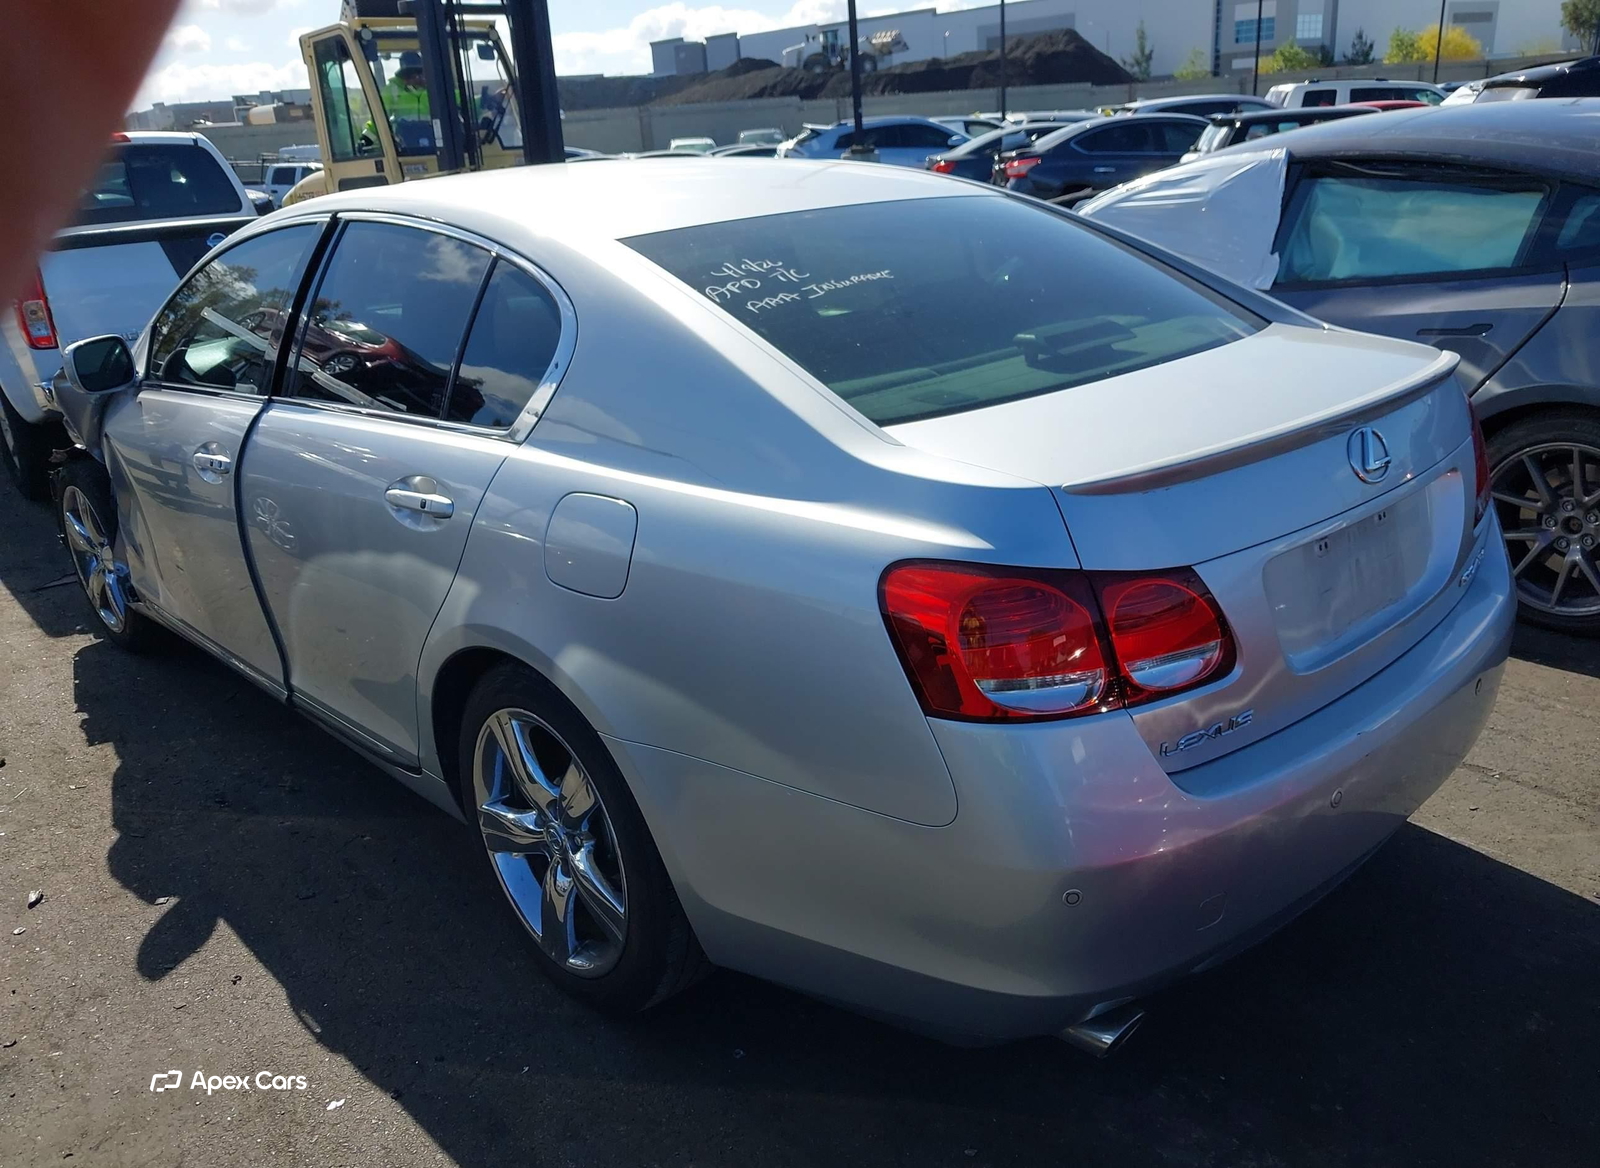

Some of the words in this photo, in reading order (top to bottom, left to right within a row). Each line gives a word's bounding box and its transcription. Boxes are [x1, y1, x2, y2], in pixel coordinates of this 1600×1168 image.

[705, 278, 761, 303] APD
[745, 292, 801, 313] AAA
[1159, 708, 1254, 757] LEXUS
